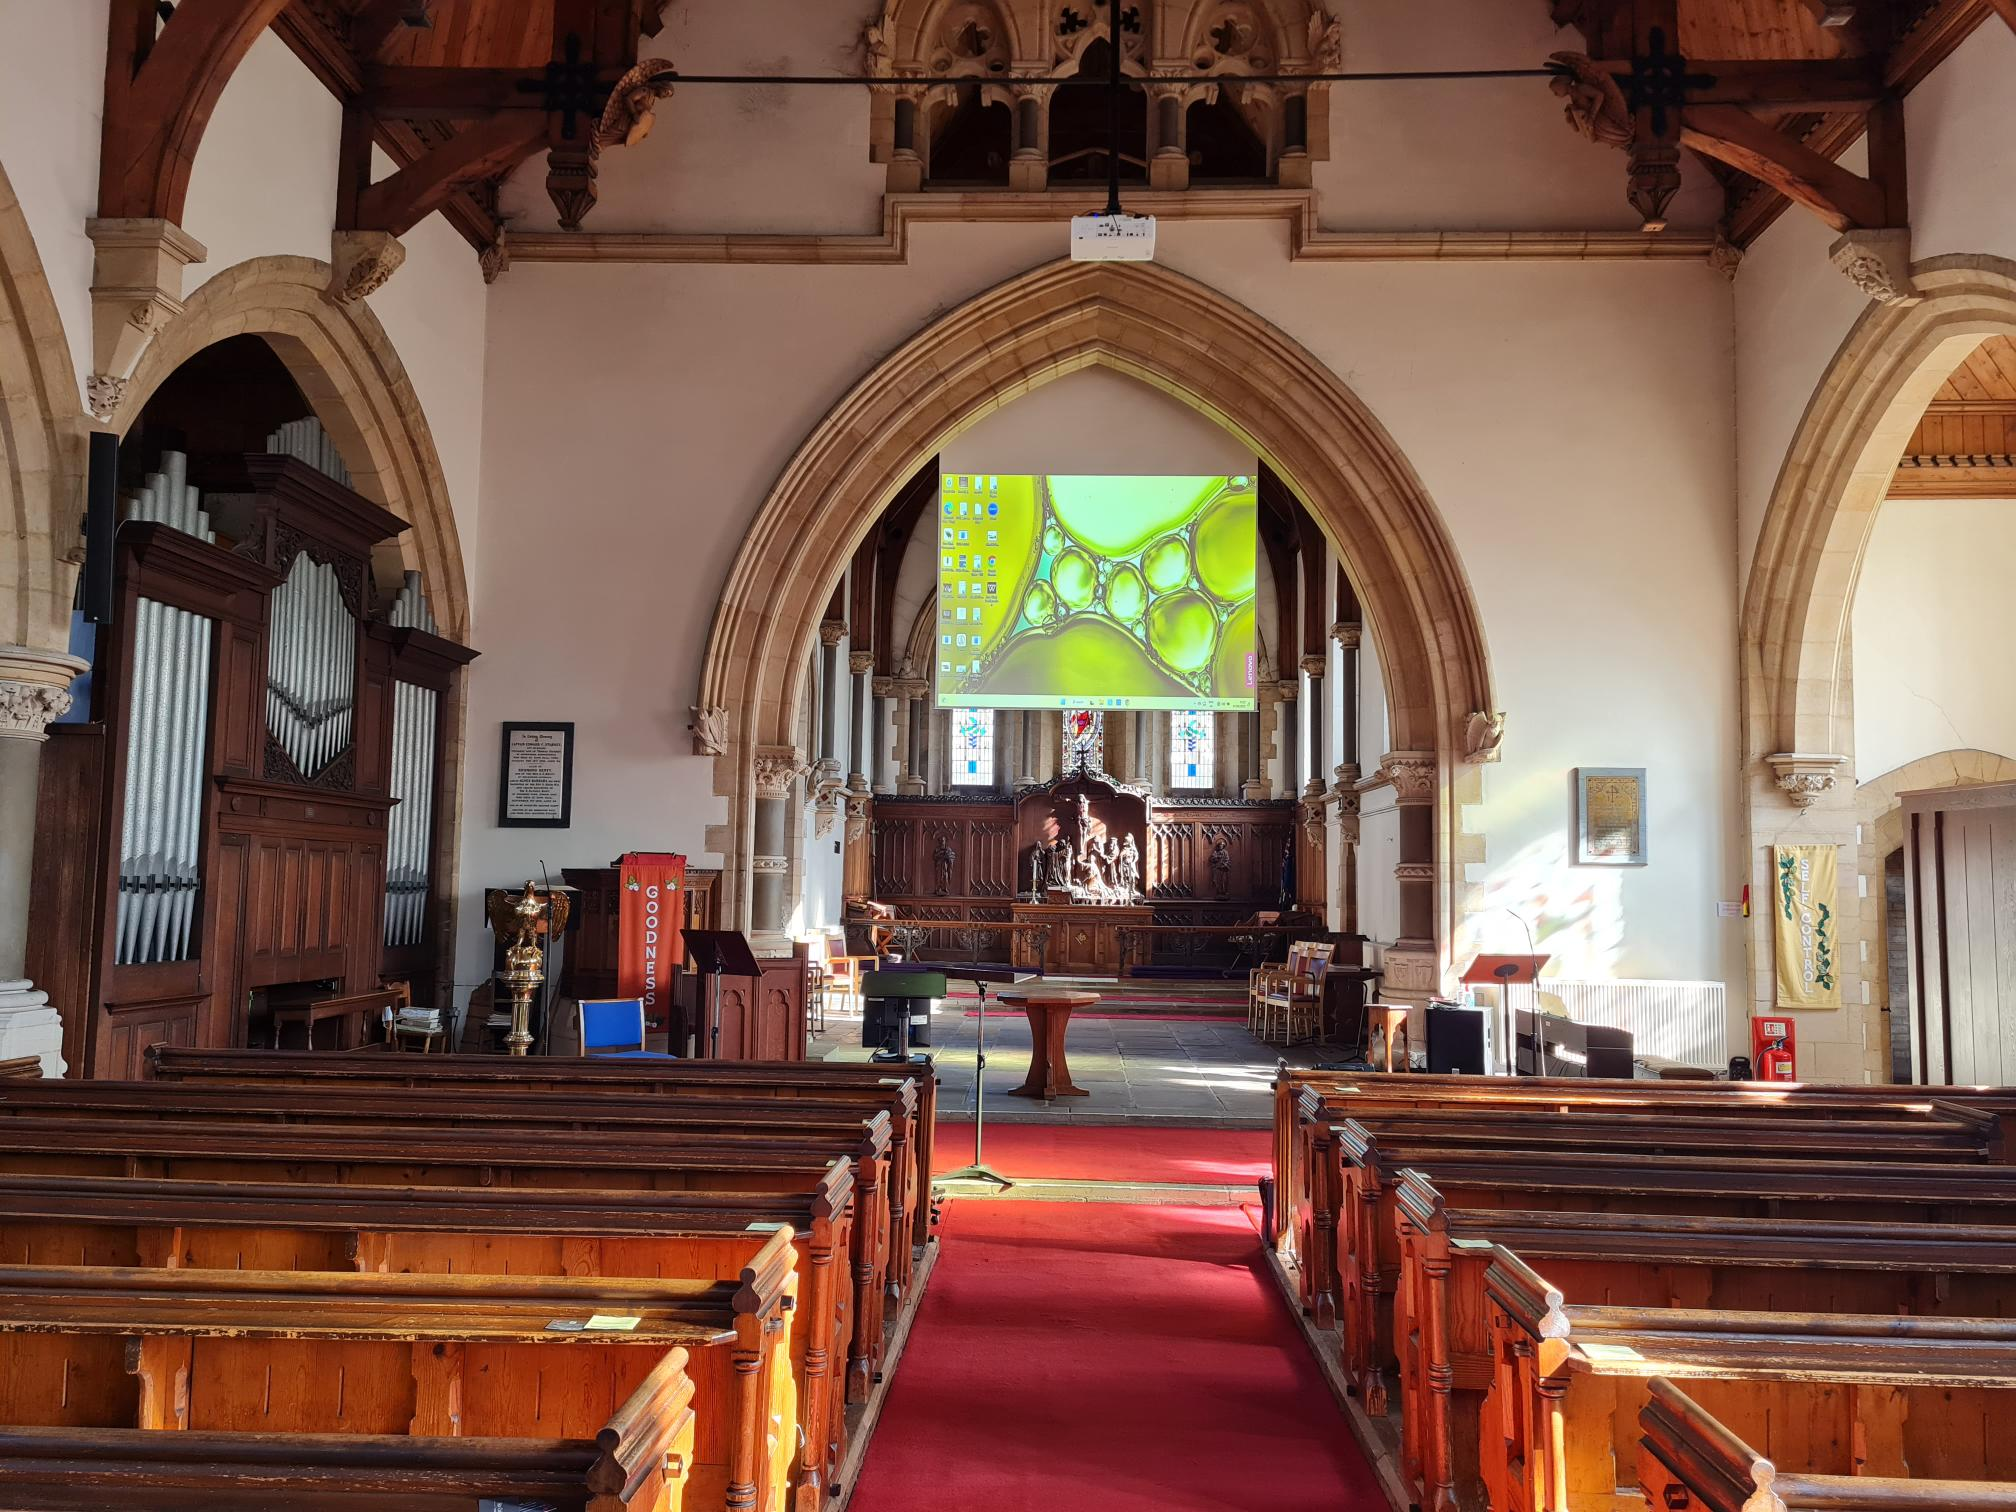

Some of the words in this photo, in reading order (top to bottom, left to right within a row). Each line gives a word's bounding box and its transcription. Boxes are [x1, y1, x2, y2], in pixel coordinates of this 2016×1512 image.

[1800, 858, 1810, 904] SELF
[645, 885, 659, 1006] GOODNESS
[1801, 912, 1814, 993] CONTROL
